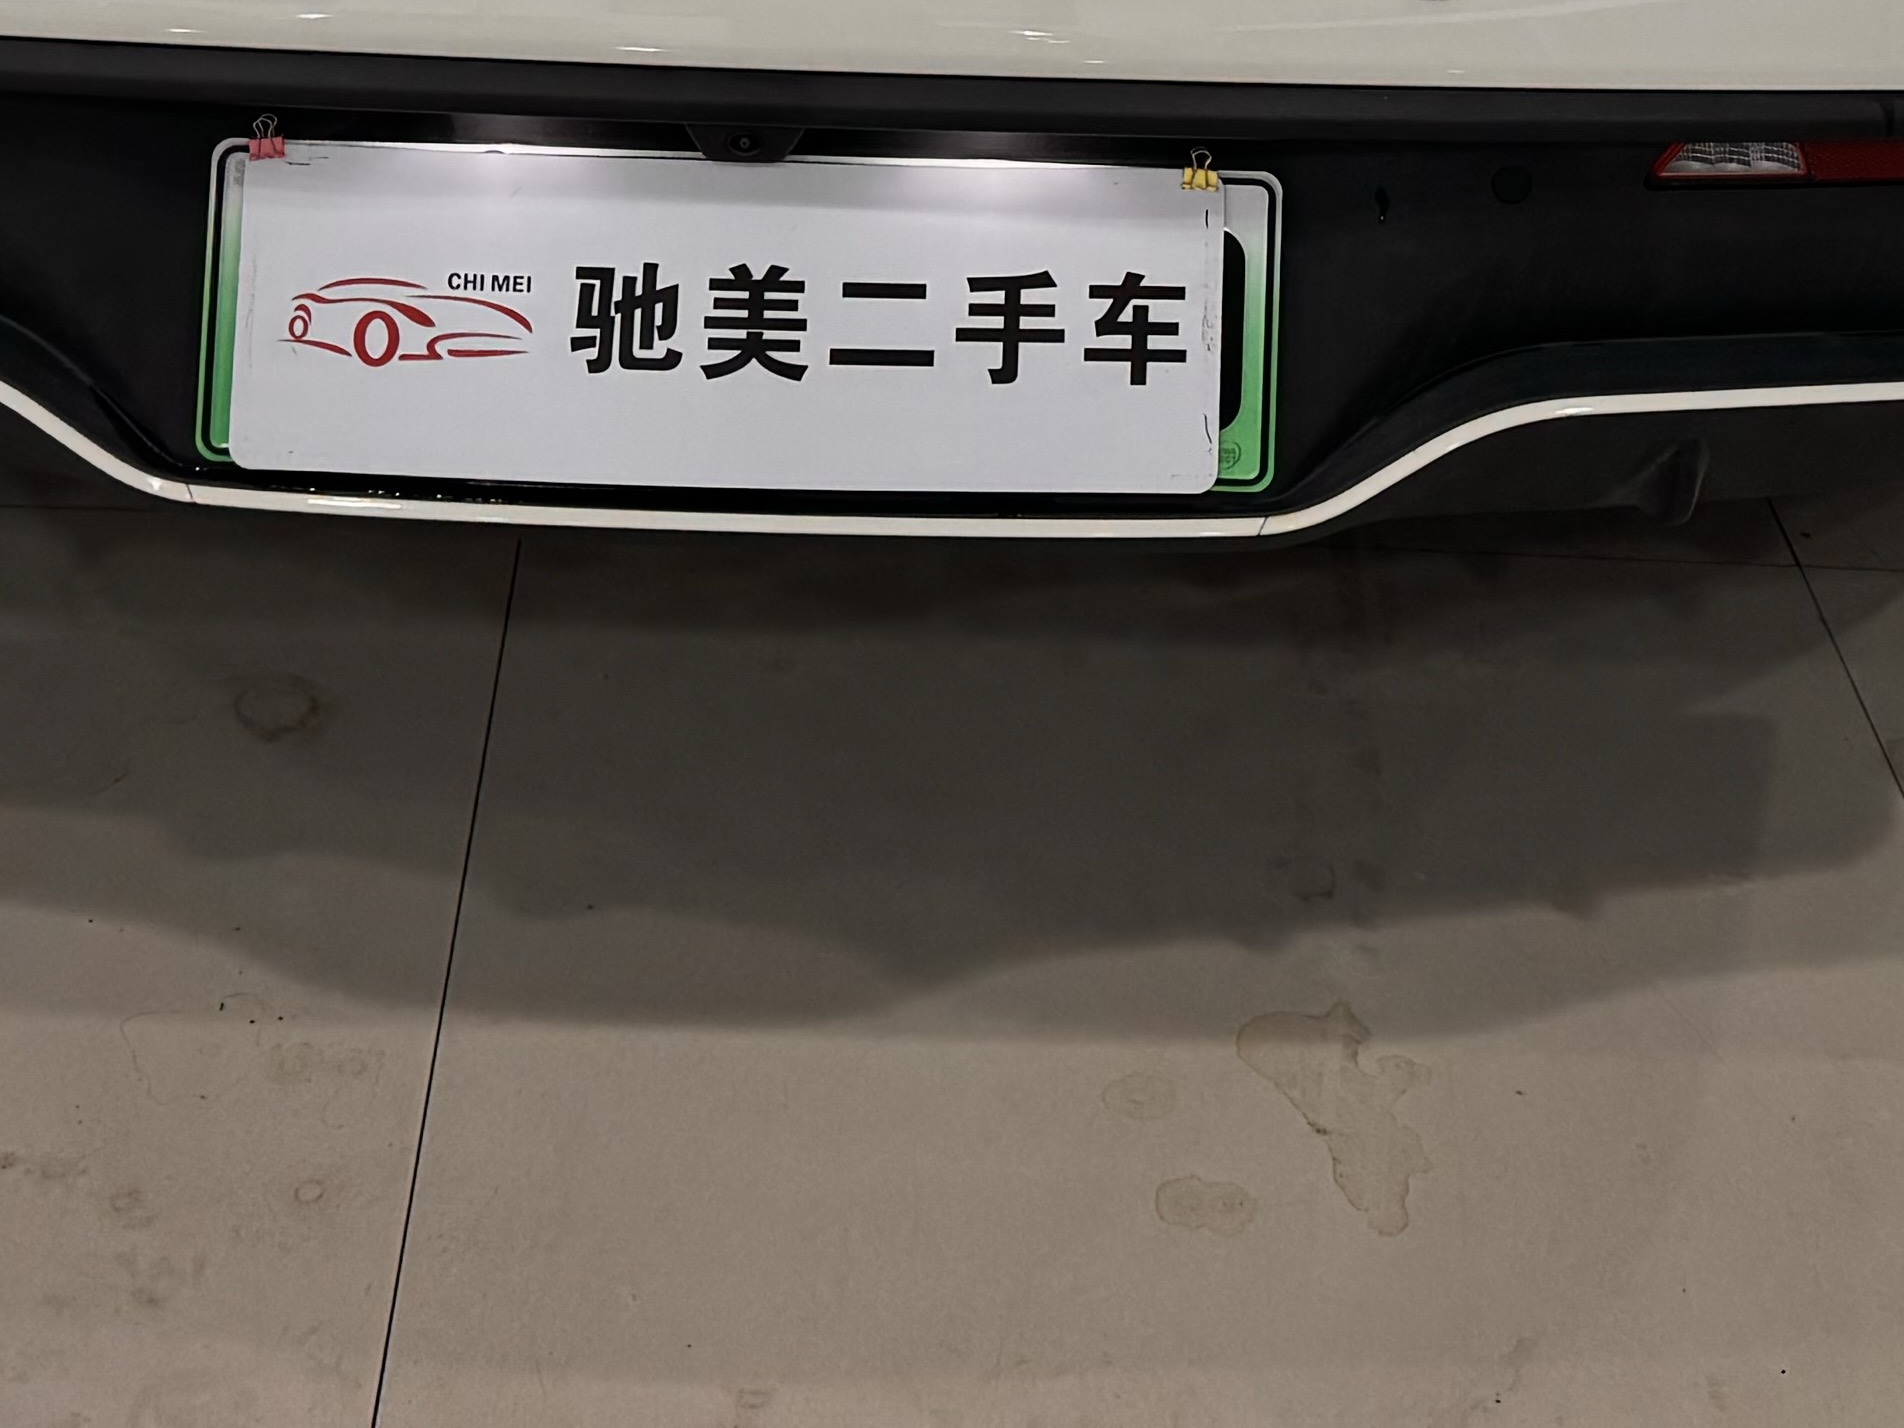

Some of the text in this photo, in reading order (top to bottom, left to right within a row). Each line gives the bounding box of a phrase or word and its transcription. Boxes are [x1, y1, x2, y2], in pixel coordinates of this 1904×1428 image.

[447, 272, 533, 294] CHI MEI
[569, 262, 1189, 387] 驰美二手车
